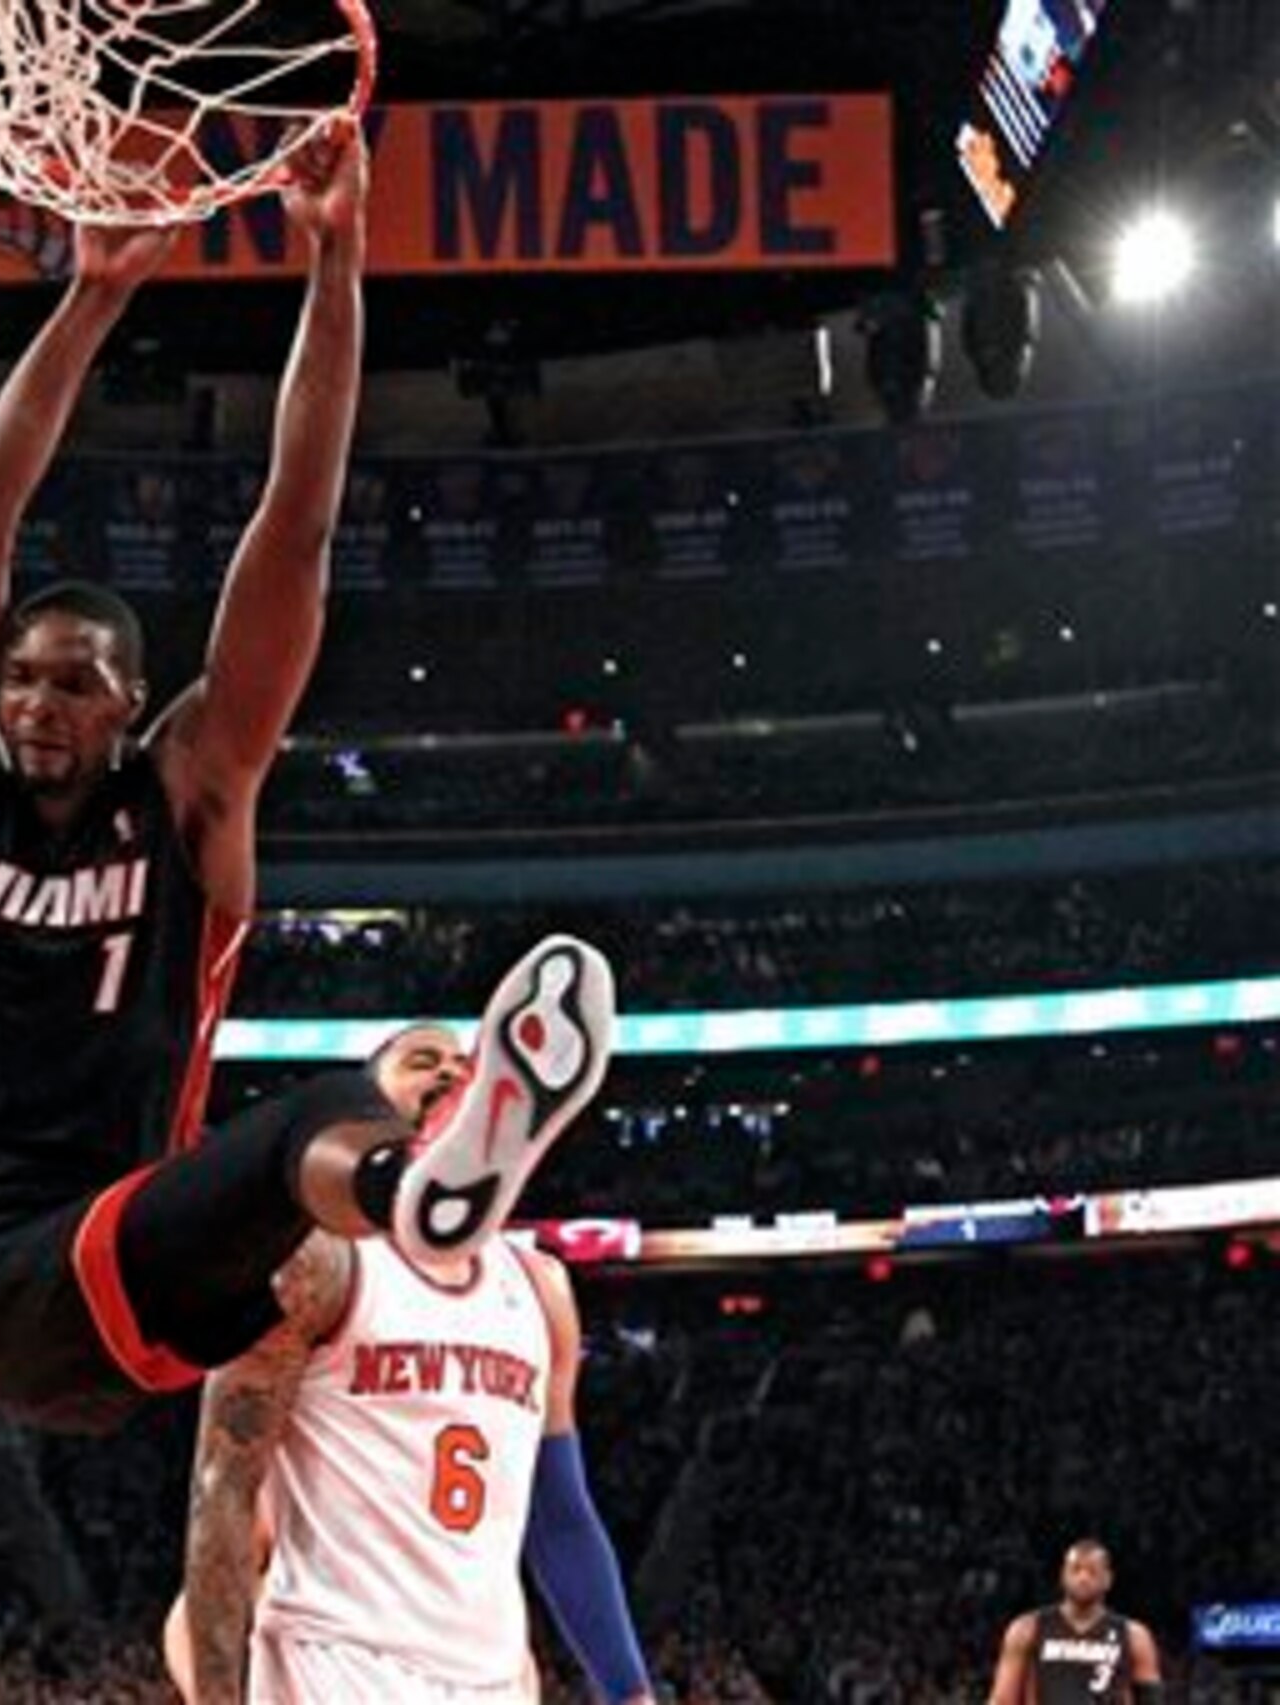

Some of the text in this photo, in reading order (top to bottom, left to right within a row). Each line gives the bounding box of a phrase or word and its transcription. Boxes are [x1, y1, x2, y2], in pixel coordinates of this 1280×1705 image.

[431, 100, 838, 260] MADE
[94, 932, 133, 1012] 1
[349, 1340, 446, 1395] NEW
[429, 1424, 490, 1534] 6
[1088, 1663, 1115, 1693] 3
